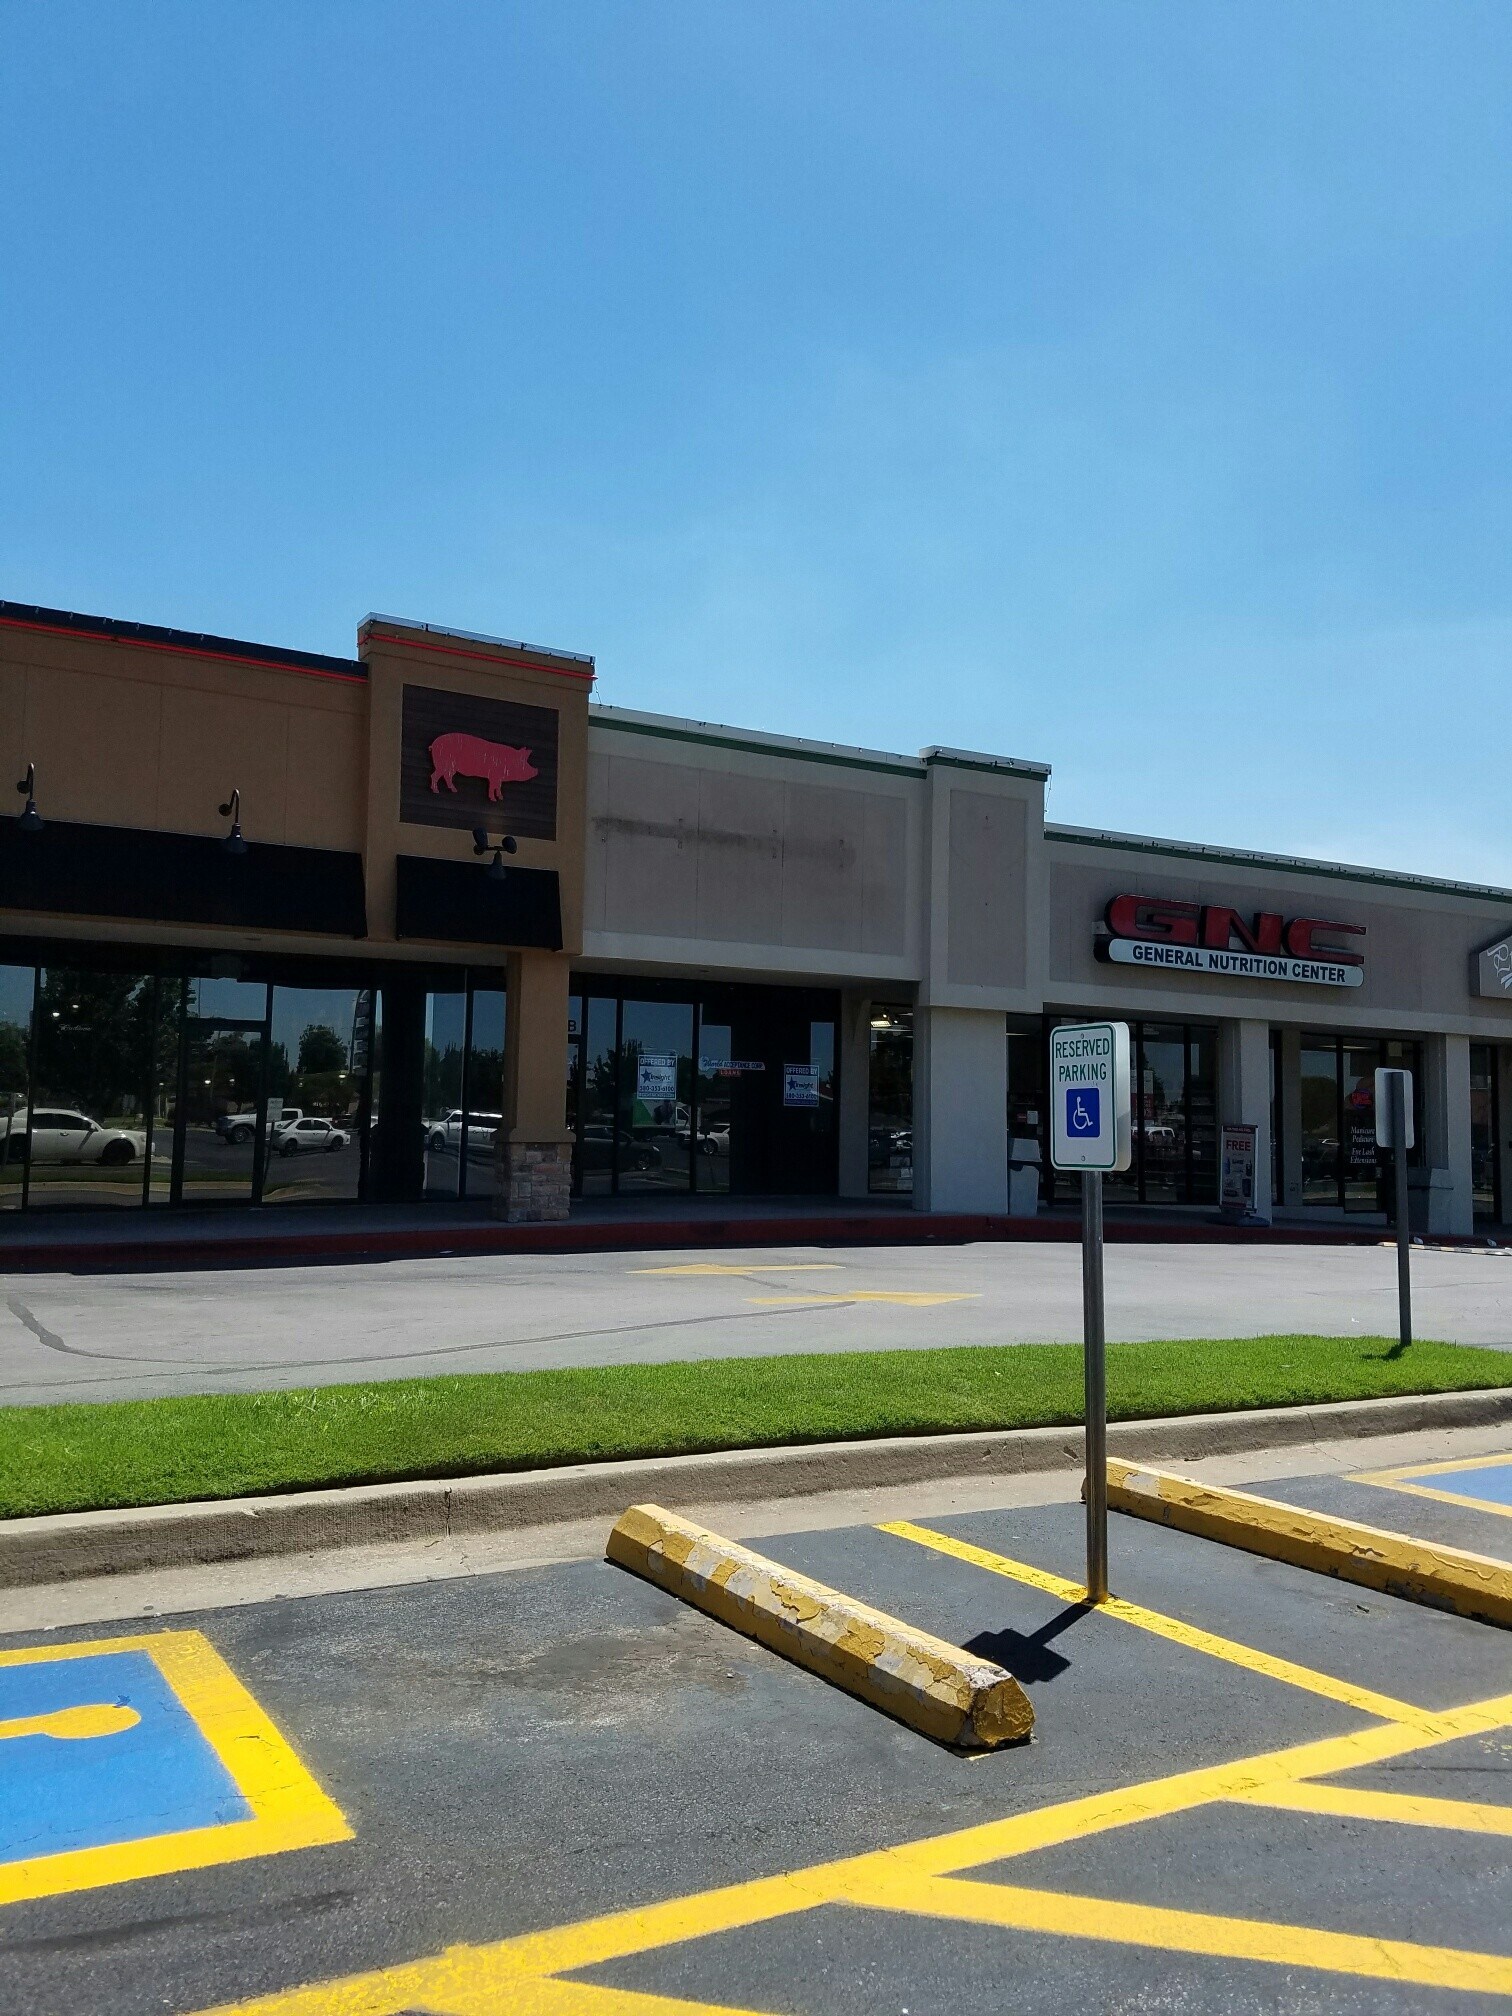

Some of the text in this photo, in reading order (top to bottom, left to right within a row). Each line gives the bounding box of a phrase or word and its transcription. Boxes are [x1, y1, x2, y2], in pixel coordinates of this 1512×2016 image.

[1105, 893, 1367, 965] GNC
[1131, 943, 1347, 983] GENERAL NUTRITION CENTER
[1055, 1037, 1110, 1059] RESERVED
[639, 1057, 676, 1066] OFFERED BY
[785, 1066, 818, 1075] OFFERED BY
[1058, 1062, 1107, 1082] PARKING
[1225, 1139, 1252, 1152] FREE
